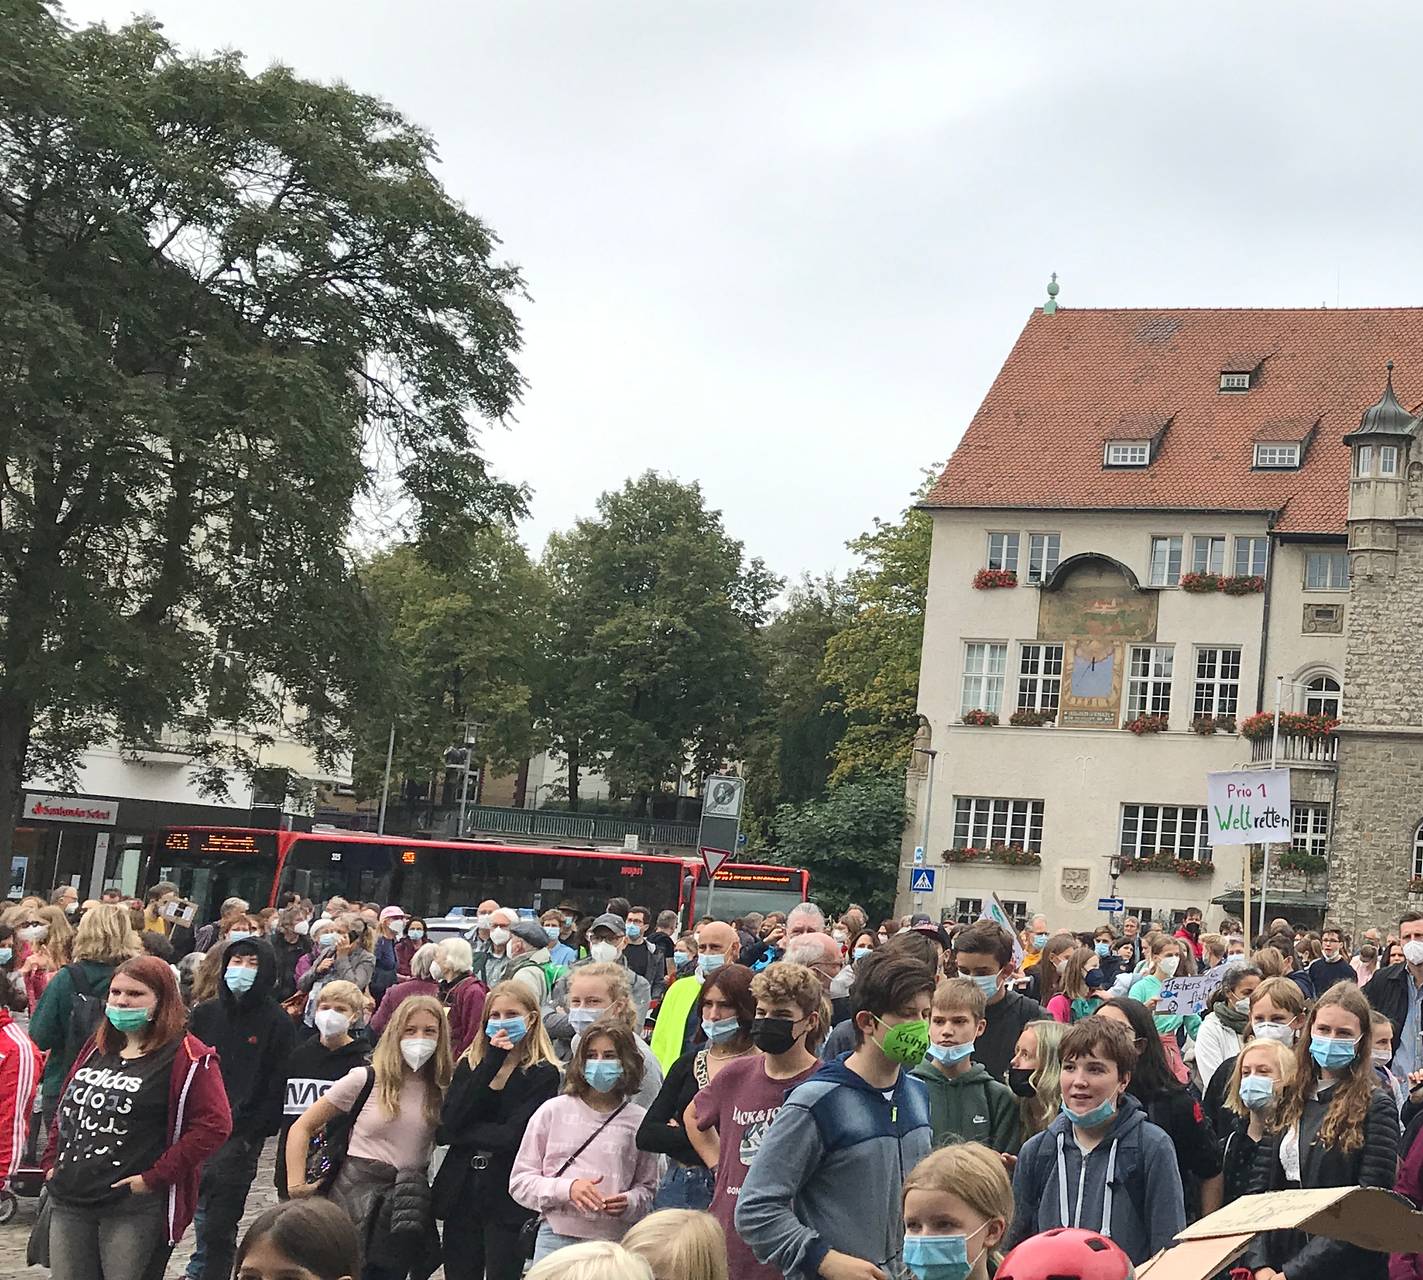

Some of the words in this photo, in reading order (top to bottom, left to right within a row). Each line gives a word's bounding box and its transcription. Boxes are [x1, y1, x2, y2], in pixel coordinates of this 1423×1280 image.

[1227, 783, 1252, 798] Prio
[1257, 783, 1267, 798] 1
[895, 1031, 928, 1053] KLIMA
[74, 1067, 143, 1093] adidas
[285, 1082, 332, 1106] NA
